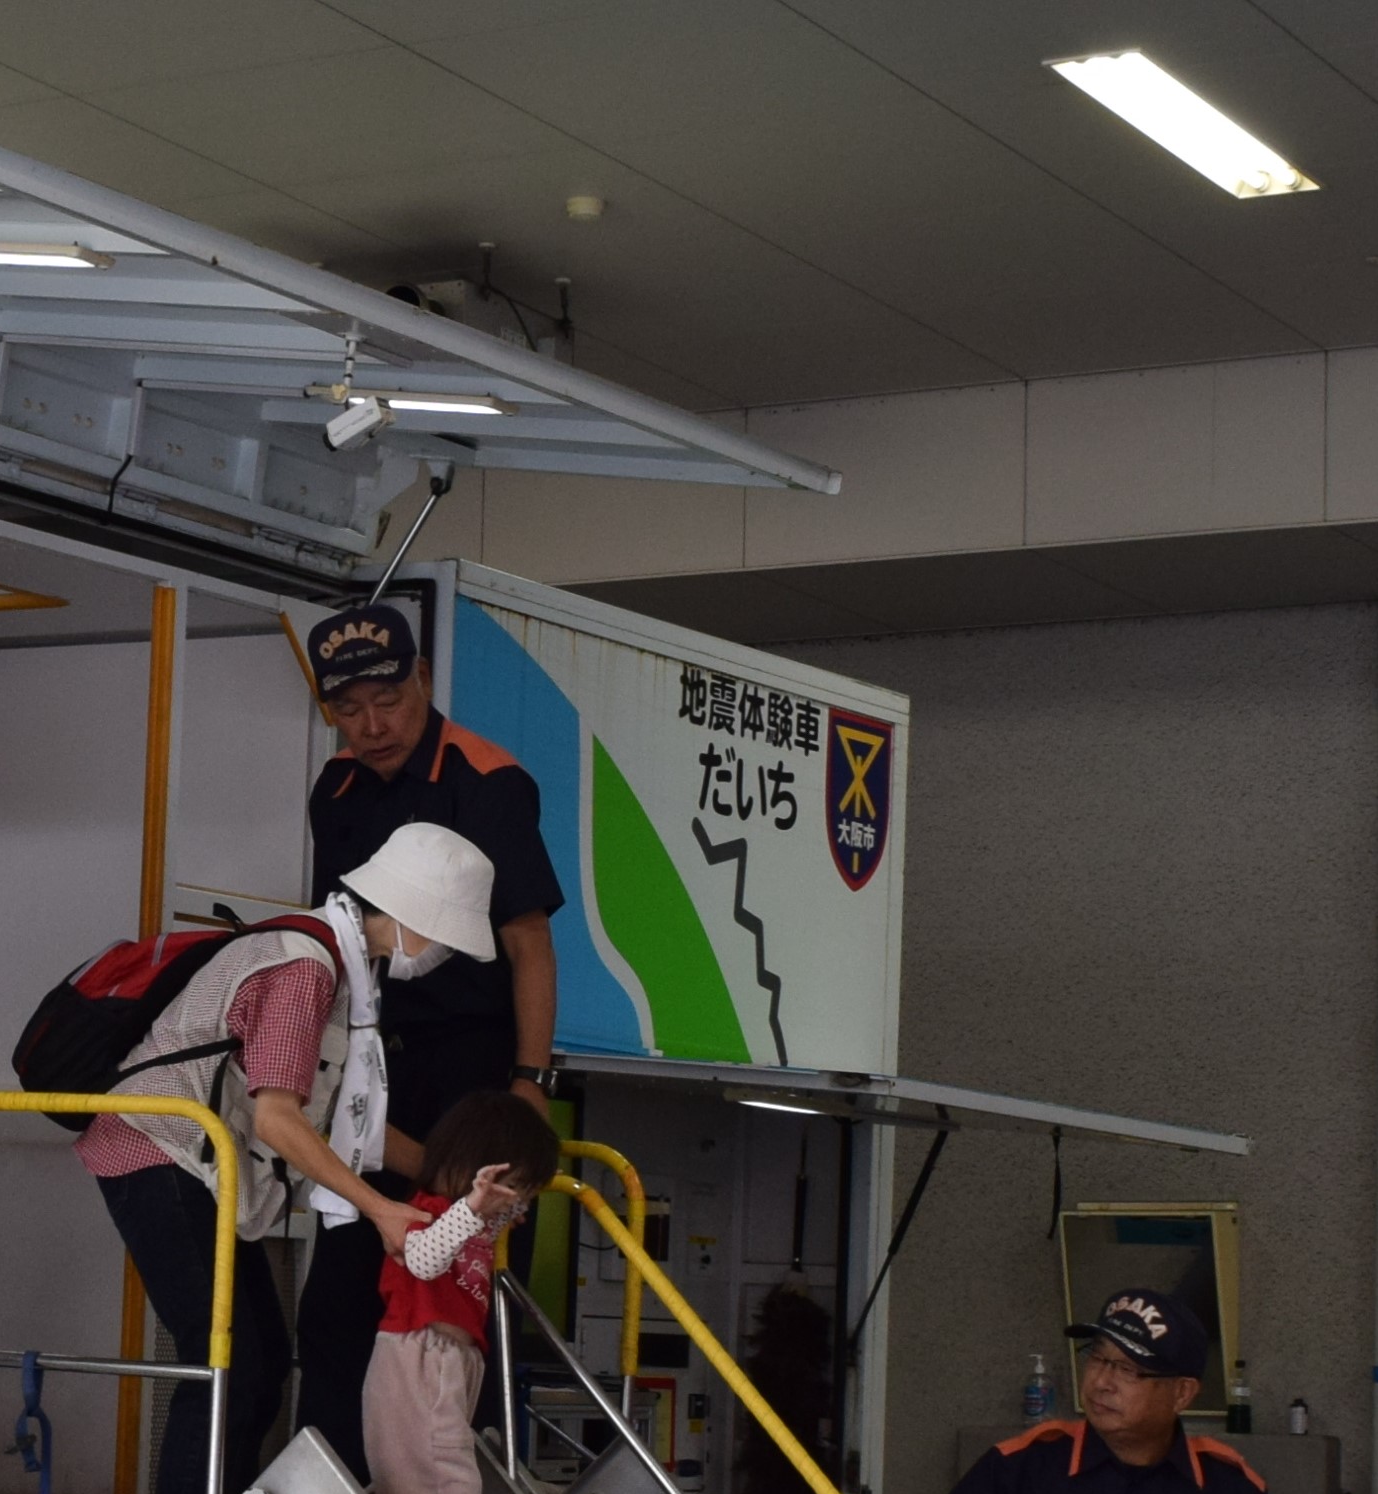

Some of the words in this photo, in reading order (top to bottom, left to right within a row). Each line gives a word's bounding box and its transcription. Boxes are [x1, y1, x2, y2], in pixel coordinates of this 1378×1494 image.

[319, 621, 390, 659] OSAKA
[679, 664, 821, 757] 地震体験車
[699, 742, 798, 831] だいち
[837, 818, 877, 851] 大阪市
[1105, 1296, 1167, 1339] OSAKA
